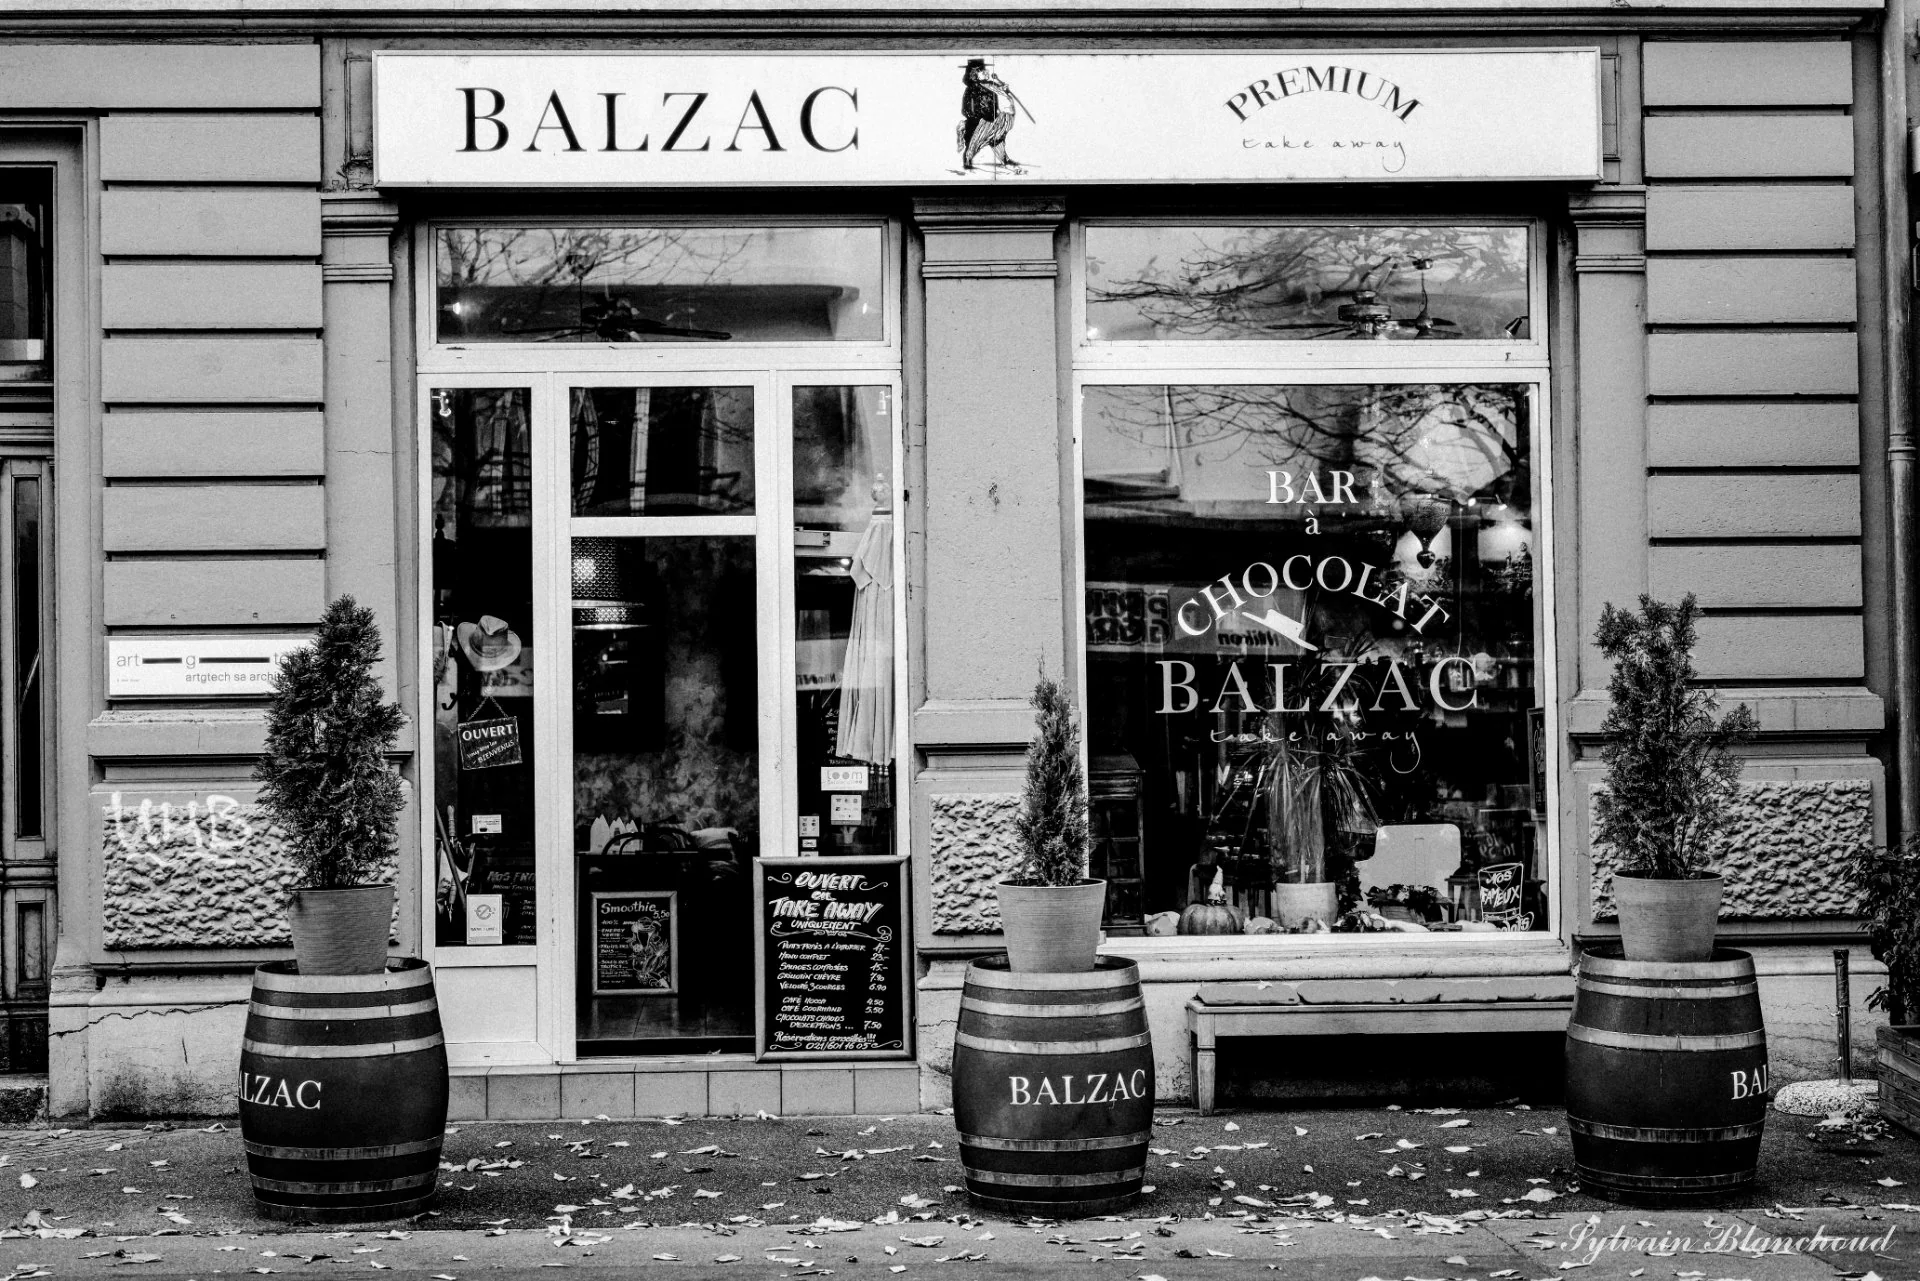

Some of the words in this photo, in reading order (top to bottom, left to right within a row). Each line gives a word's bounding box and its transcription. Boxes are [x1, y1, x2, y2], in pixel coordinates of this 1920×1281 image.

[1223, 66, 1424, 124] PREMIUM
[455, 86, 859, 152] BALZAC
[1242, 136, 1315, 149] take
[1332, 139, 1406, 173] away
[1265, 470, 1359, 504] BAR
[1305, 510, 1321, 535] à
[1177, 555, 1450, 637] CHOCOLAT
[116, 653, 140, 667] art
[185, 671, 230, 684] artgtech
[234, 674, 246, 682] sa
[1156, 657, 1478, 714] BALZAC
[462, 724, 513, 741] OUVERT
[1210, 729, 1302, 743] take
[1326, 730, 1421, 774] away
[795, 872, 867, 890] OUVERT
[1481, 885, 1520, 908] FAMEUX
[601, 901, 657, 914] Smoothie
[769, 897, 820, 918] TAKE
[823, 901, 884, 923] AWAY
[791, 920, 861, 930] UNIQUEMENT
[779, 962, 812, 971] SALADES
[781, 1003, 800, 1012] CAFÉ
[782, 995, 802, 1004] CAFÉ
[775, 1013, 816, 1023] CHOCOLATS
[864, 1020, 882, 1030] 7.50
[1009, 1069, 1146, 1105] BALZAC
